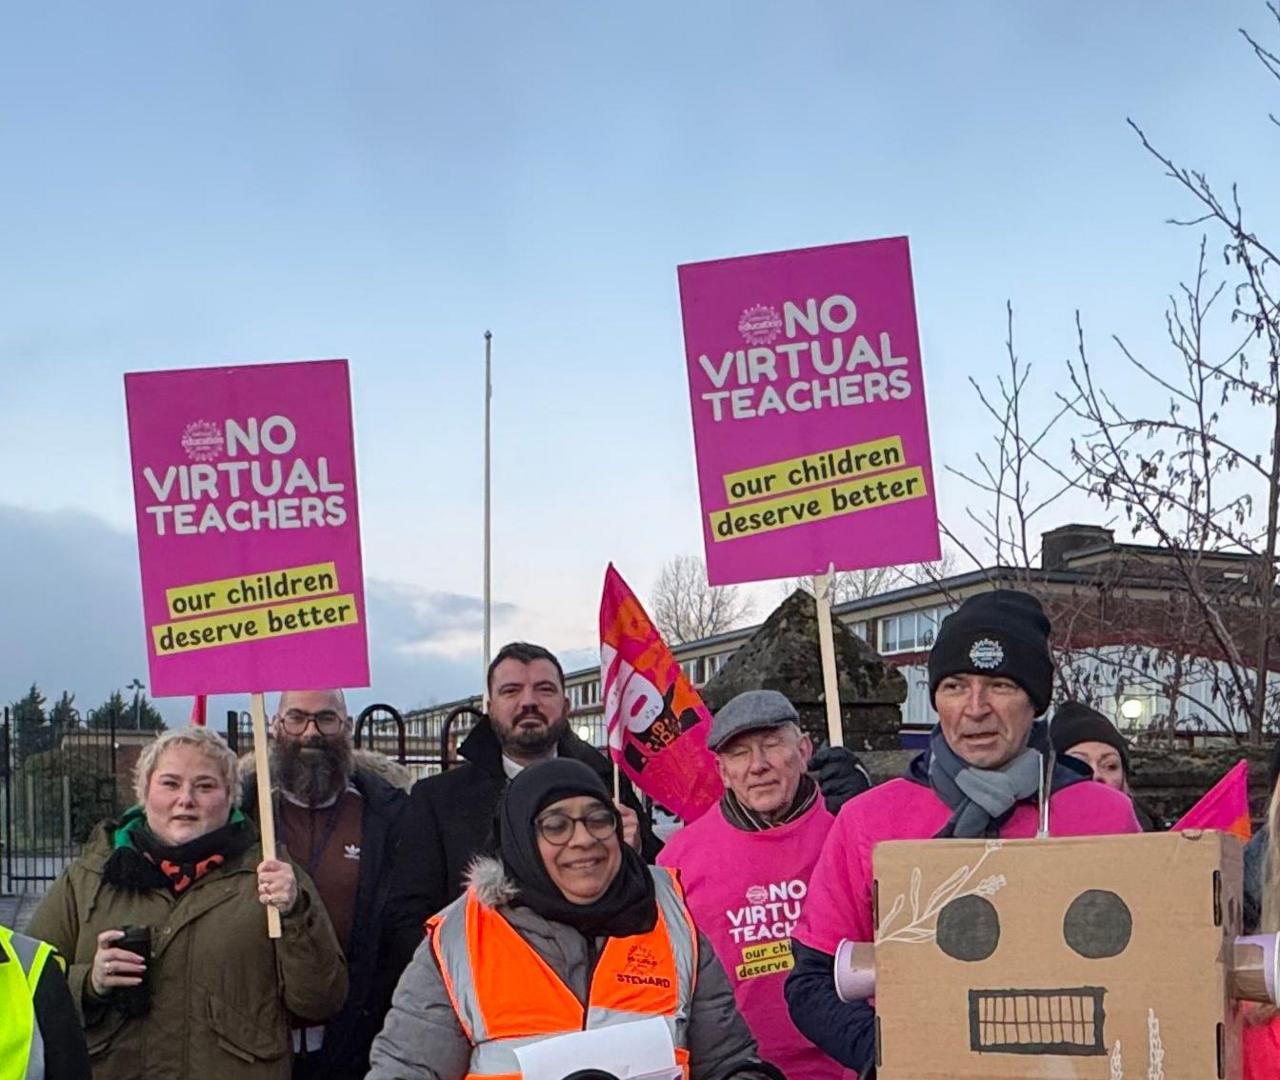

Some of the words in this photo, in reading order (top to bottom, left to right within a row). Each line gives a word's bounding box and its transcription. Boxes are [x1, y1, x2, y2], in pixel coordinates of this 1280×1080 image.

[783, 295, 857, 338] NO
[699, 332, 908, 388] VIRTUAL
[702, 369, 912, 422] TEACHERS
[225, 415, 297, 456] NO
[143, 457, 345, 502] VIRTUAL
[731, 476, 776, 499] our
[788, 446, 899, 486] children
[146, 496, 347, 535] TEACHERS
[718, 500, 822, 536] deserve
[832, 476, 918, 511] better
[172, 591, 216, 614] our
[227, 571, 334, 605] children
[160, 619, 258, 650] deserve
[269, 603, 351, 632] better
[769, 880, 807, 901] NO
[726, 901, 801, 927] VIRTU
[729, 921, 797, 944] TEACH
[739, 961, 789, 978] deserve
[745, 947, 767, 960] our
[617, 973, 670, 988] STEWARD
